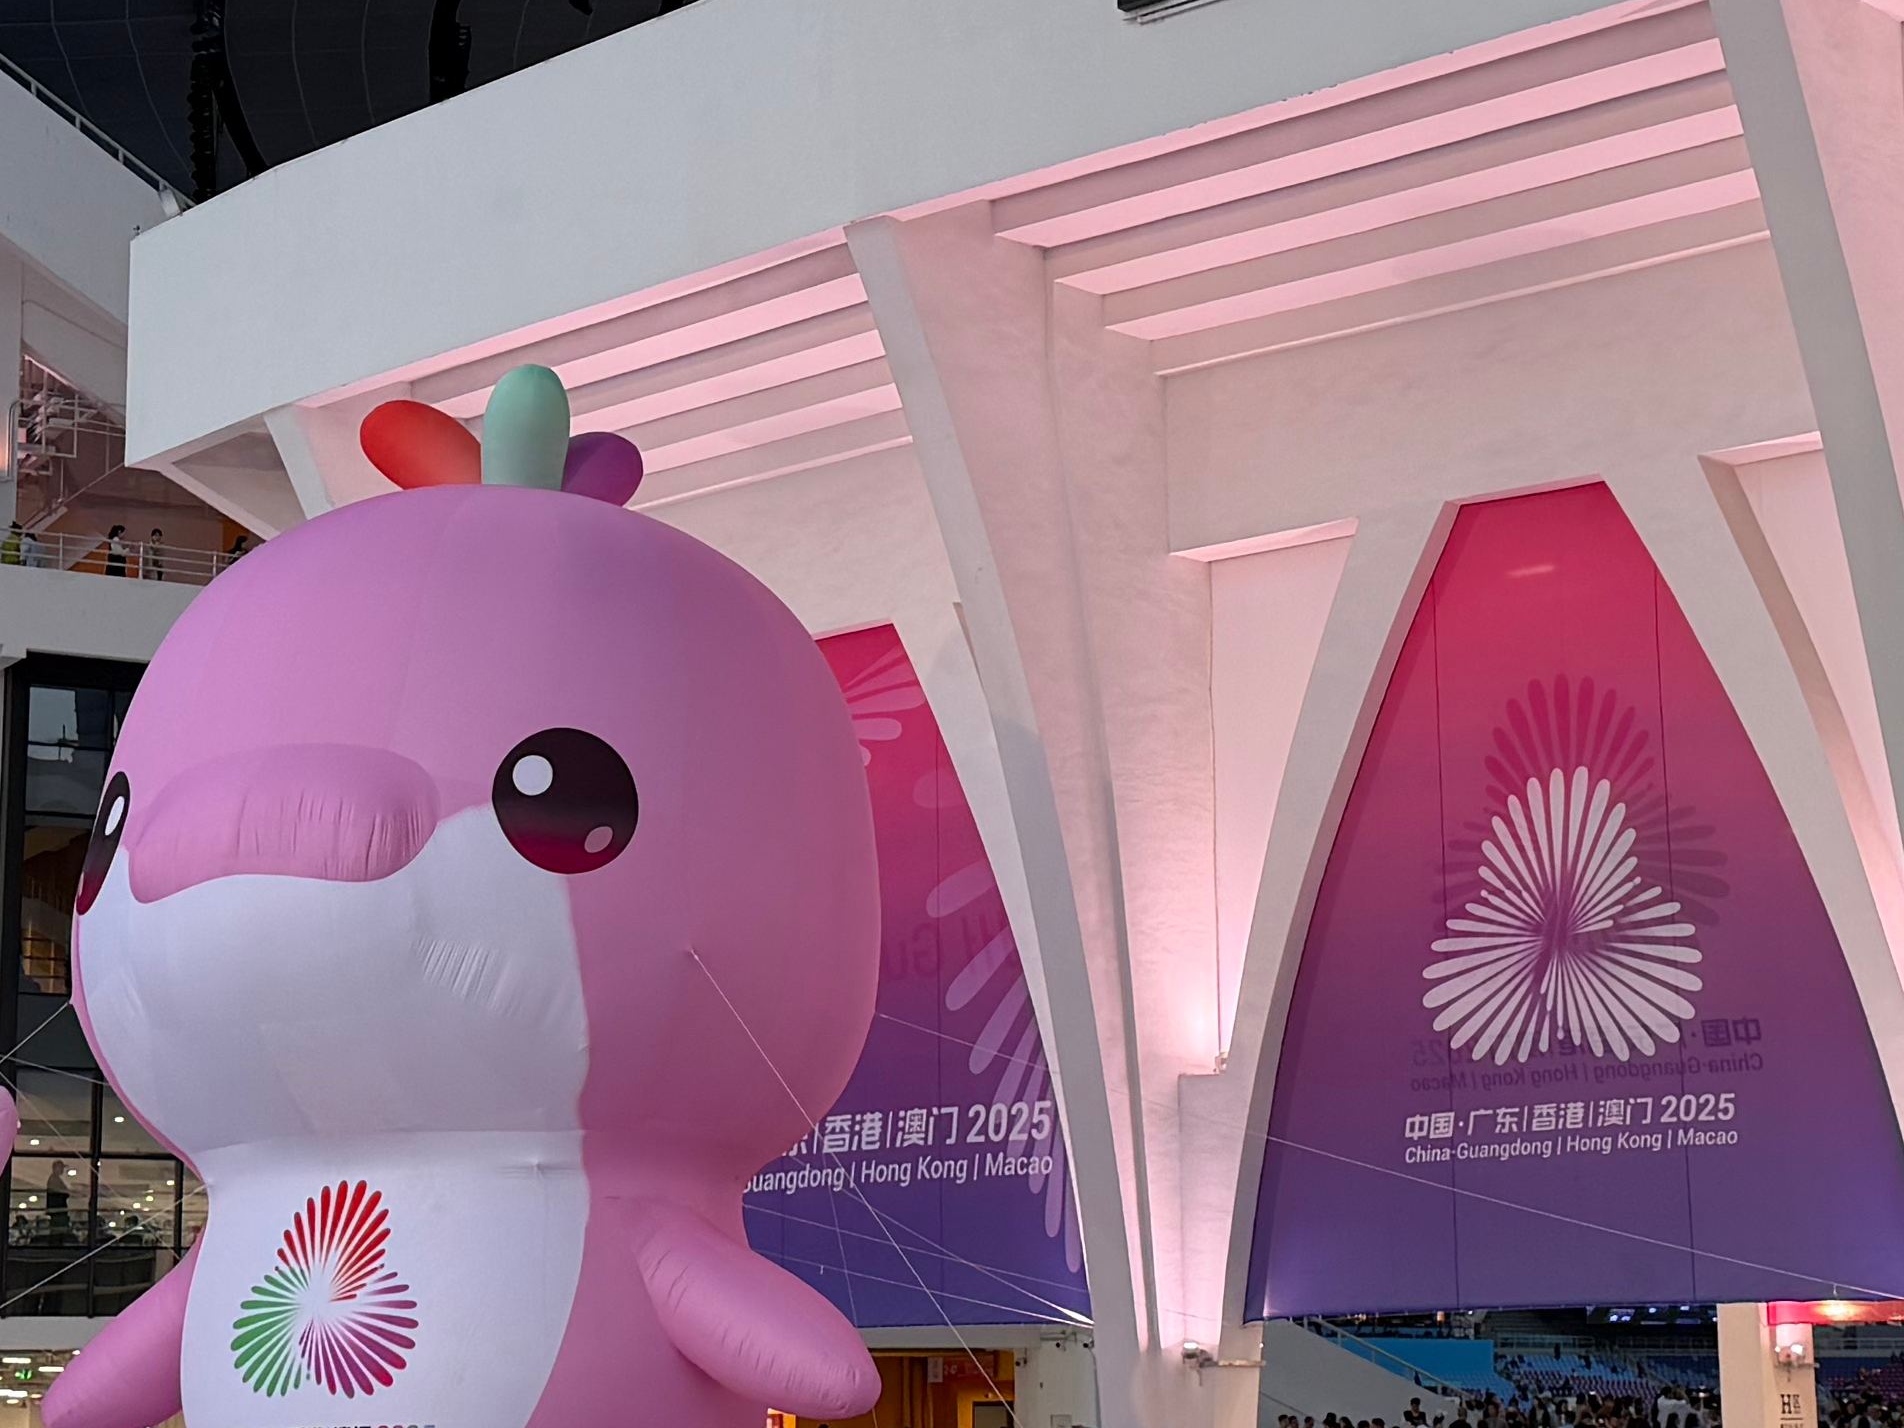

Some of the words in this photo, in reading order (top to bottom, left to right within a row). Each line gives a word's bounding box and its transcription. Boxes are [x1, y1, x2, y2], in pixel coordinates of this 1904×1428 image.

[967, 1099, 1053, 1143] 2025
[1660, 1093, 1736, 1124] 2025
[1566, 1135, 1612, 1155] Hong
[1617, 1132, 1662, 1151] Kong
[1678, 1129, 1738, 1147] Macao
[861, 1156, 912, 1189] Hong
[917, 1154, 968, 1185] Kong
[985, 1152, 1053, 1178] Macao
